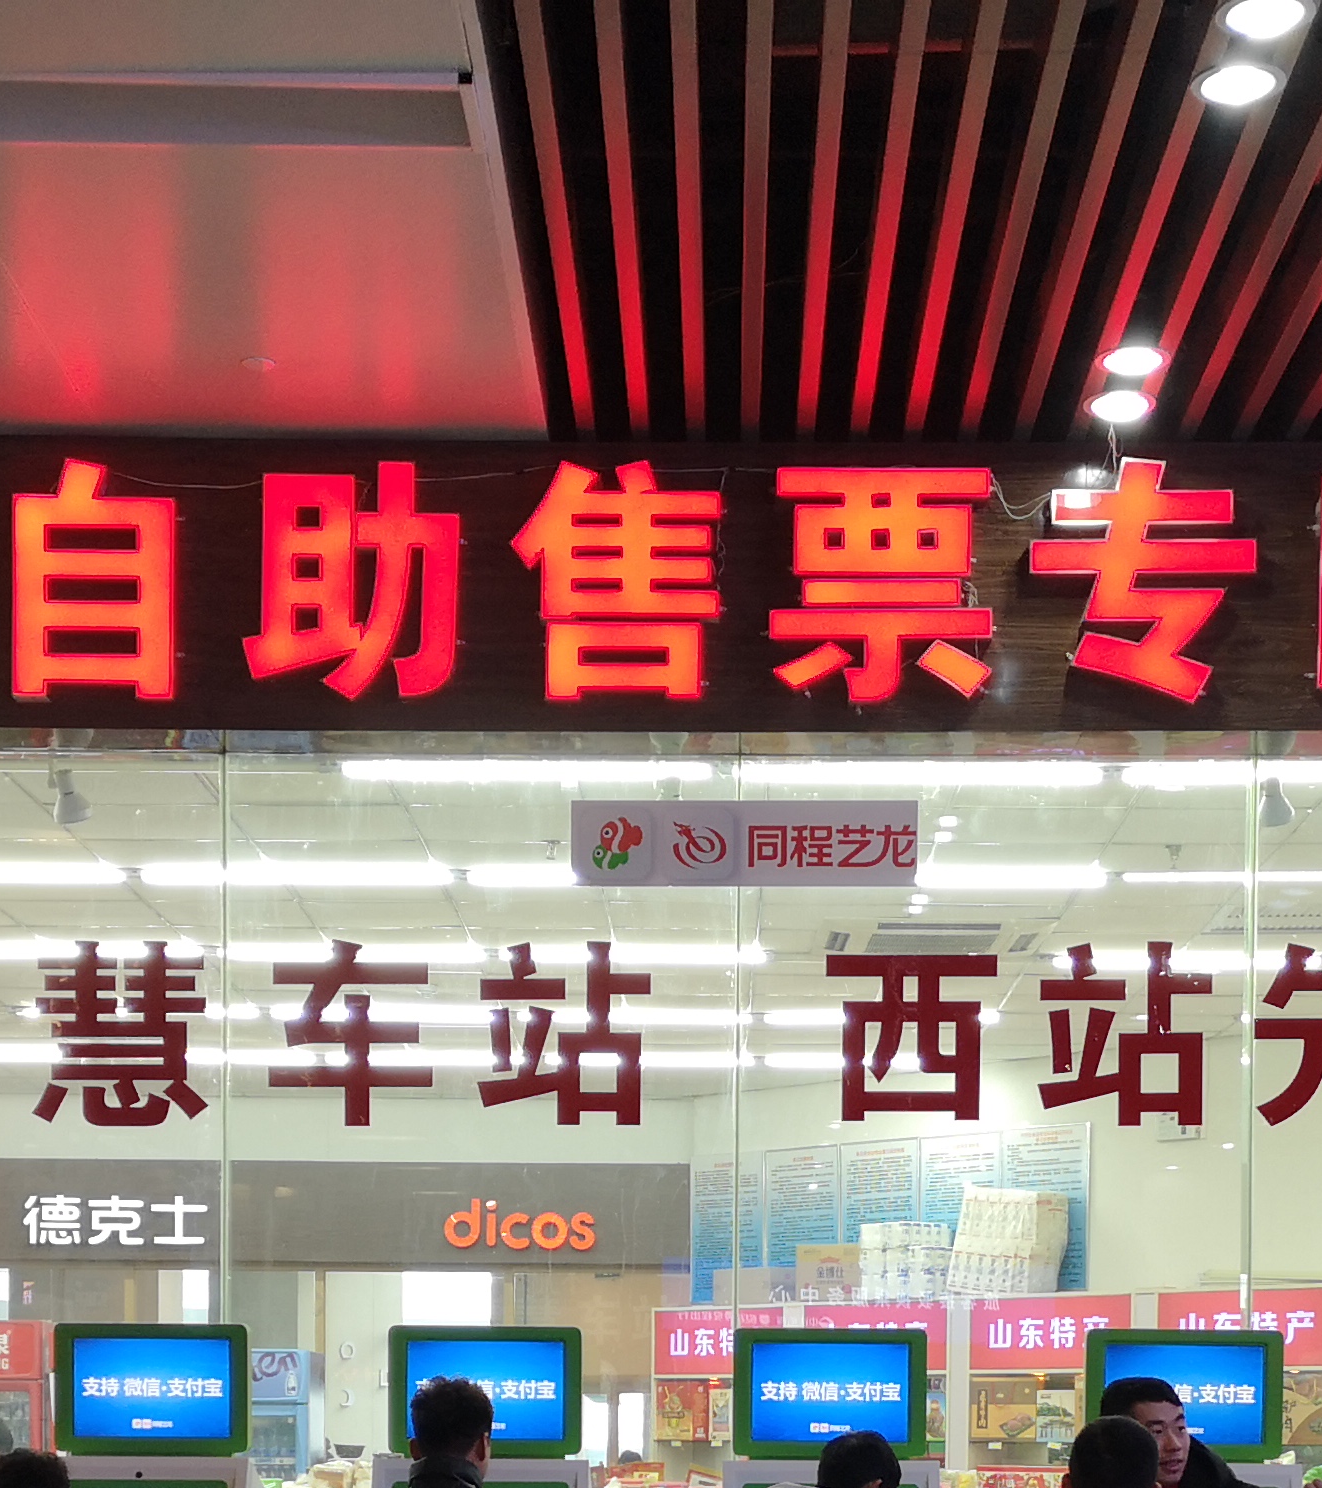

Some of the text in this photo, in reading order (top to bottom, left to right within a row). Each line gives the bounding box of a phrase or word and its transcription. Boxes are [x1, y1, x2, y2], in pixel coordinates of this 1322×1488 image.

[747, 823, 916, 869] 同程艺龙
[24, 1194, 208, 1246] 德克士
[444, 1198, 597, 1252] dicos
[82, 1377, 224, 1397] 支持 微信·支付宝
[470, 1380, 557, 1400] 信·支付宝
[760, 1381, 902, 1401] 支持 微信·支付宝
